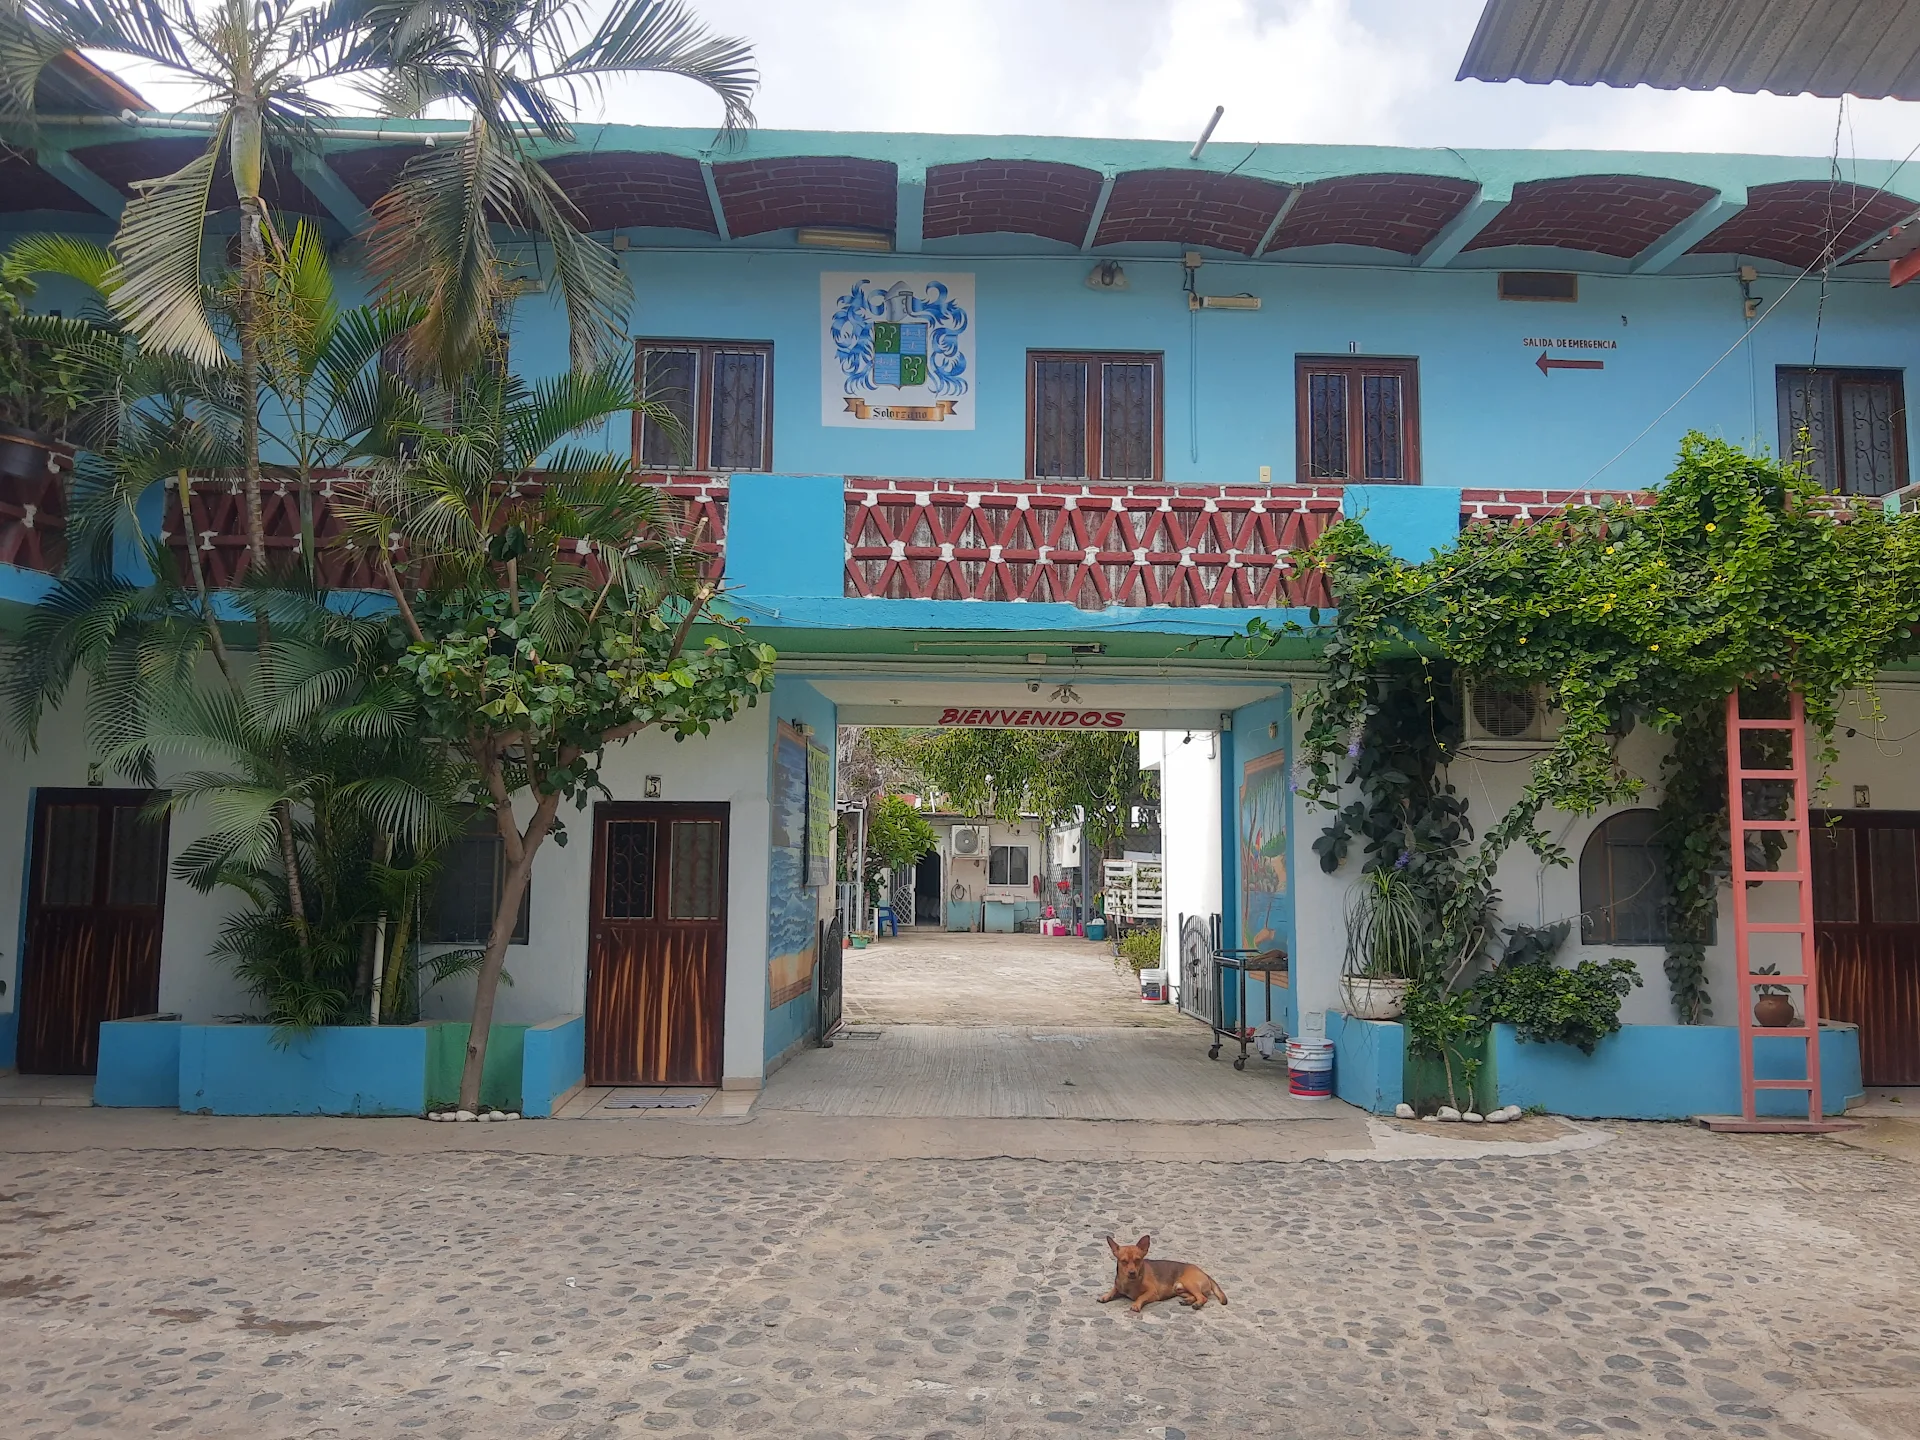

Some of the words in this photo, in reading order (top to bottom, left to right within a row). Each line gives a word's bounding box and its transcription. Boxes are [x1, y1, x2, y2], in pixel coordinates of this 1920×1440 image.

[1523, 338, 1554, 348] SALIDA
[1556, 339, 1567, 348] DE
[1568, 339, 1617, 349] EMERGENCIA
[873, 407, 928, 419] Solorzano
[938, 708, 1126, 728] BIENVENIDOS
[649, 780, 657, 793] 5
[1859, 791, 1866, 803] 3
